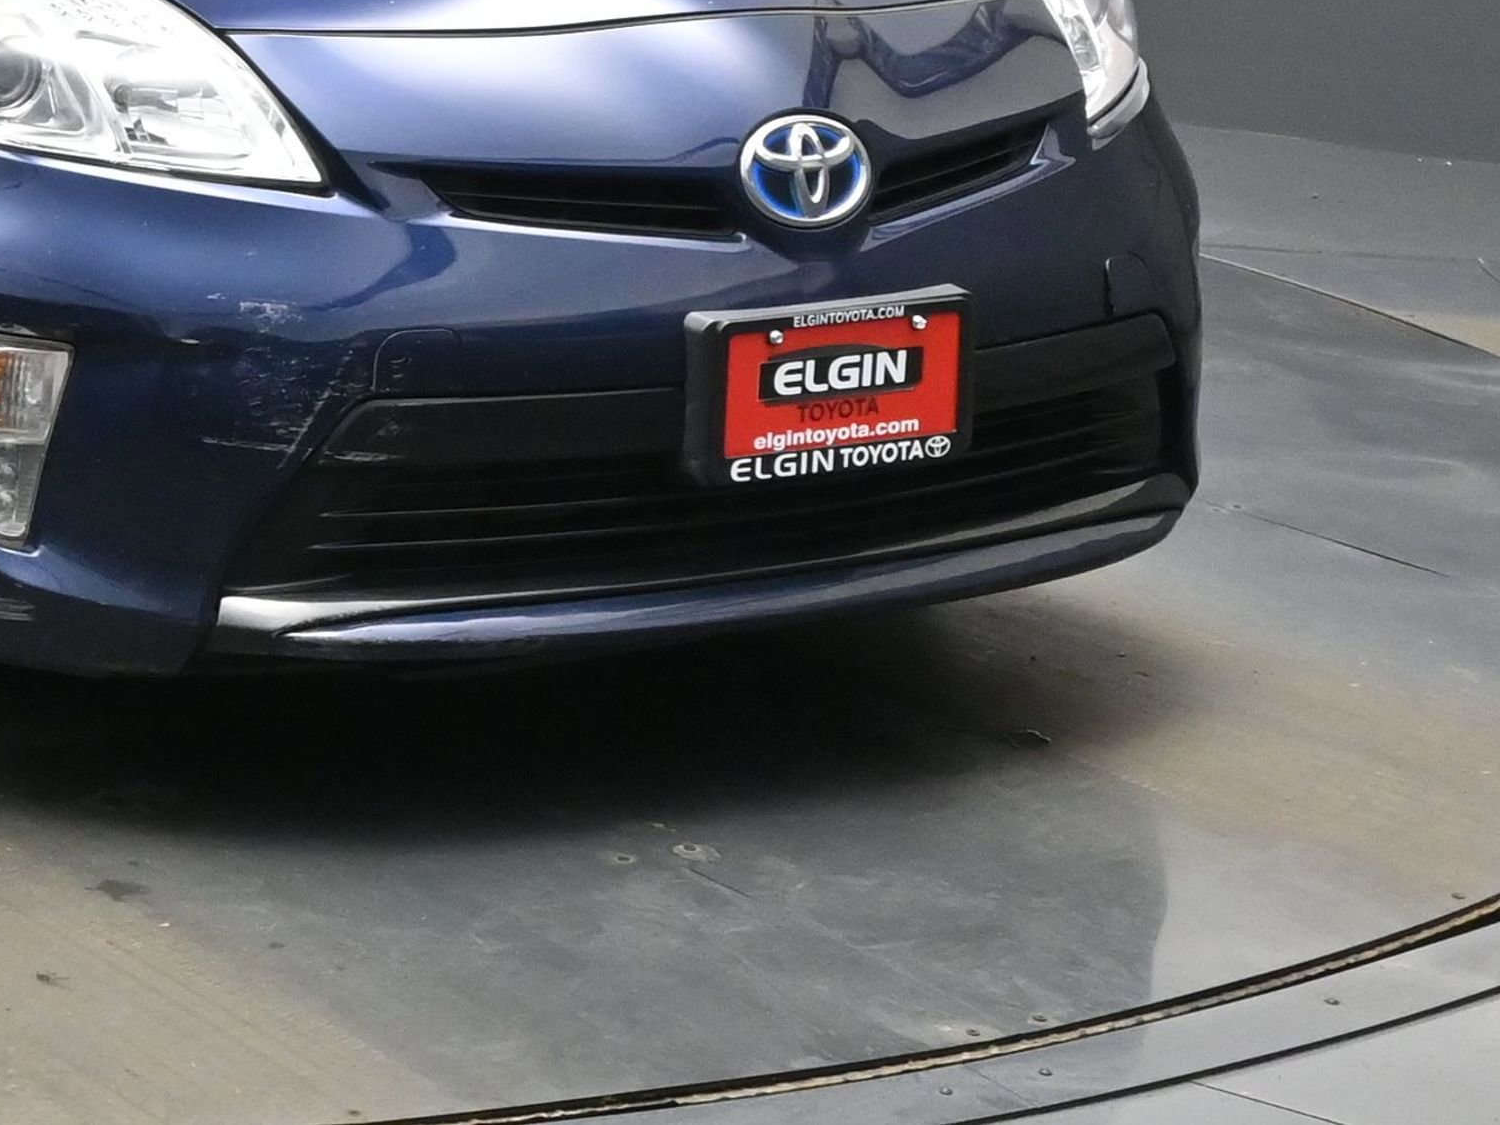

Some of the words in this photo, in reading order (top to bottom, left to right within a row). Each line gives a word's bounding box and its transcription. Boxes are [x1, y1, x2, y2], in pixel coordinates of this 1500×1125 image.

[792, 305, 905, 329] ELGINTOYOTA.COM
[772, 349, 908, 396] ELGIN
[797, 397, 880, 424] TOYOTA
[753, 418, 920, 452] elgintoyota.com
[730, 448, 836, 483] ELGIN
[839, 438, 925, 469] TOYOTA
